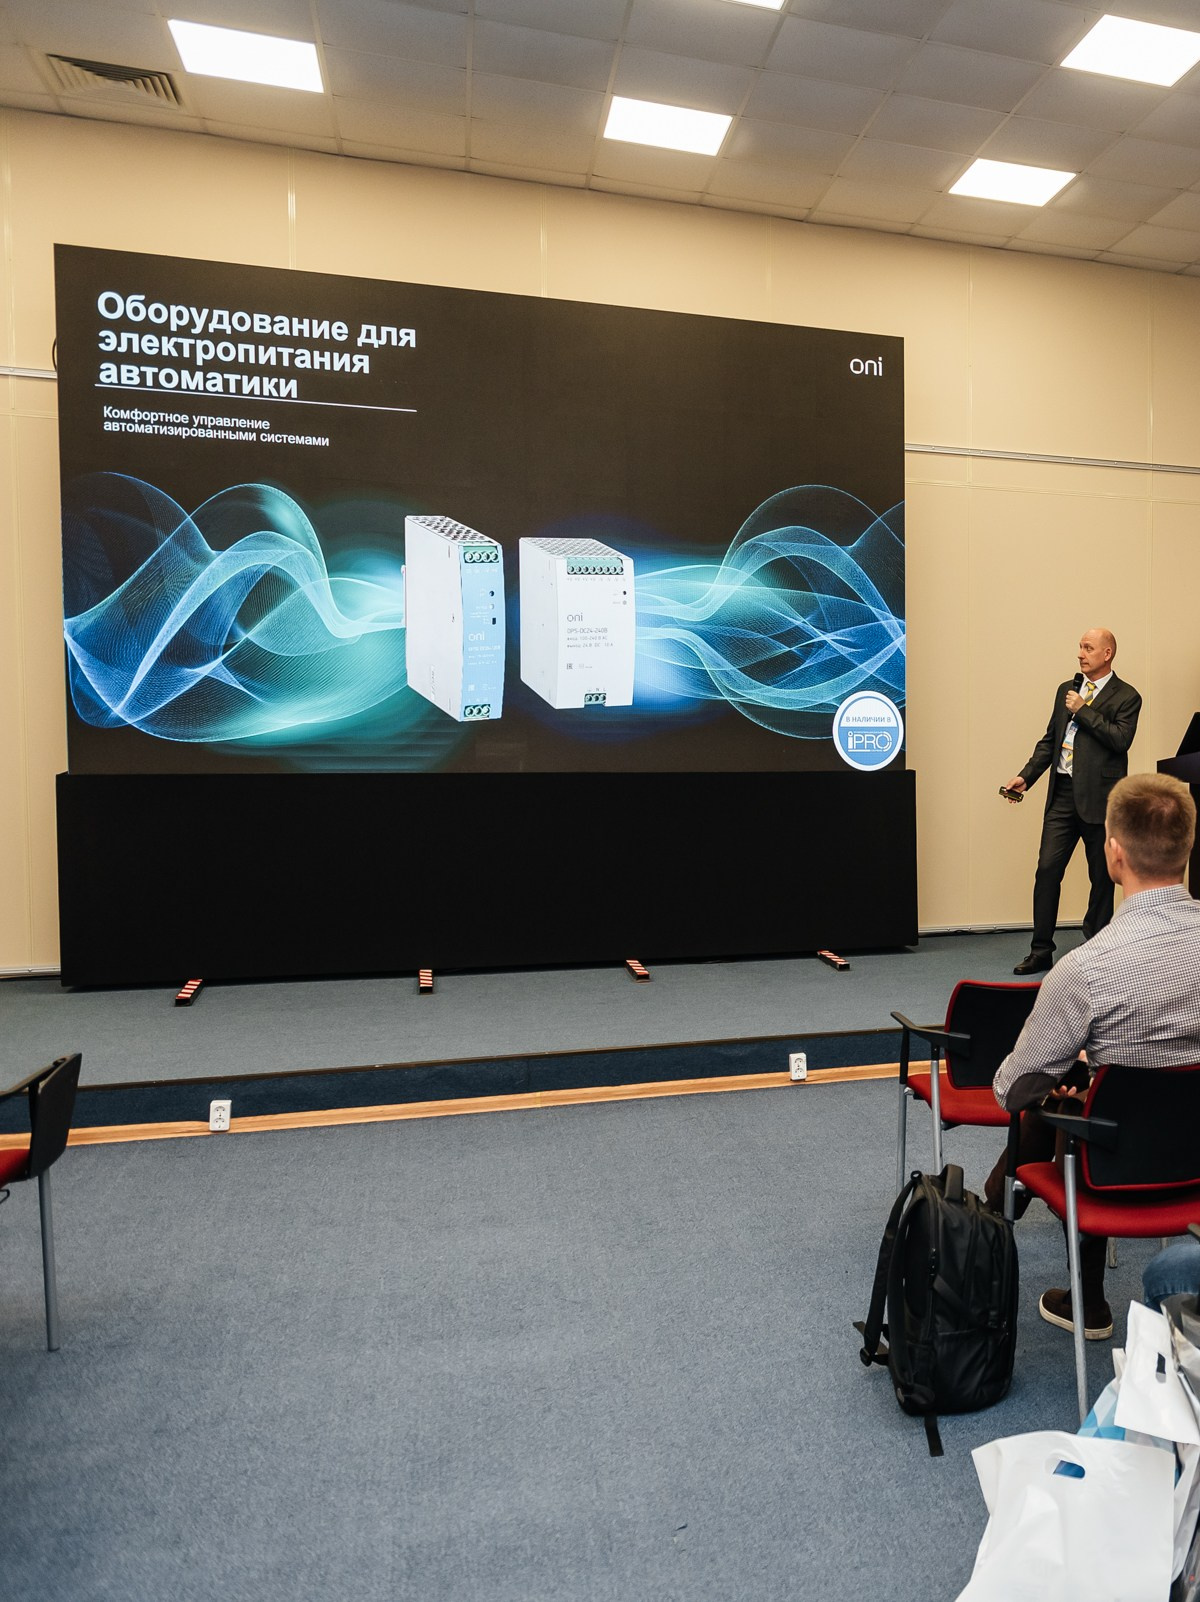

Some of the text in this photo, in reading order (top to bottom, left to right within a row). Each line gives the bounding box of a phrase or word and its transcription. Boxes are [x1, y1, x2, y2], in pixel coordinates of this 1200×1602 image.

[97, 291, 416, 347] Оборудование для
[98, 330, 370, 374] электропитания
[850, 356, 883, 376] oni
[99, 361, 298, 399] автоматики
[103, 406, 270, 430] Комфортное управление
[103, 420, 329, 447] автоматизированными системами
[567, 612, 583, 622] oni
